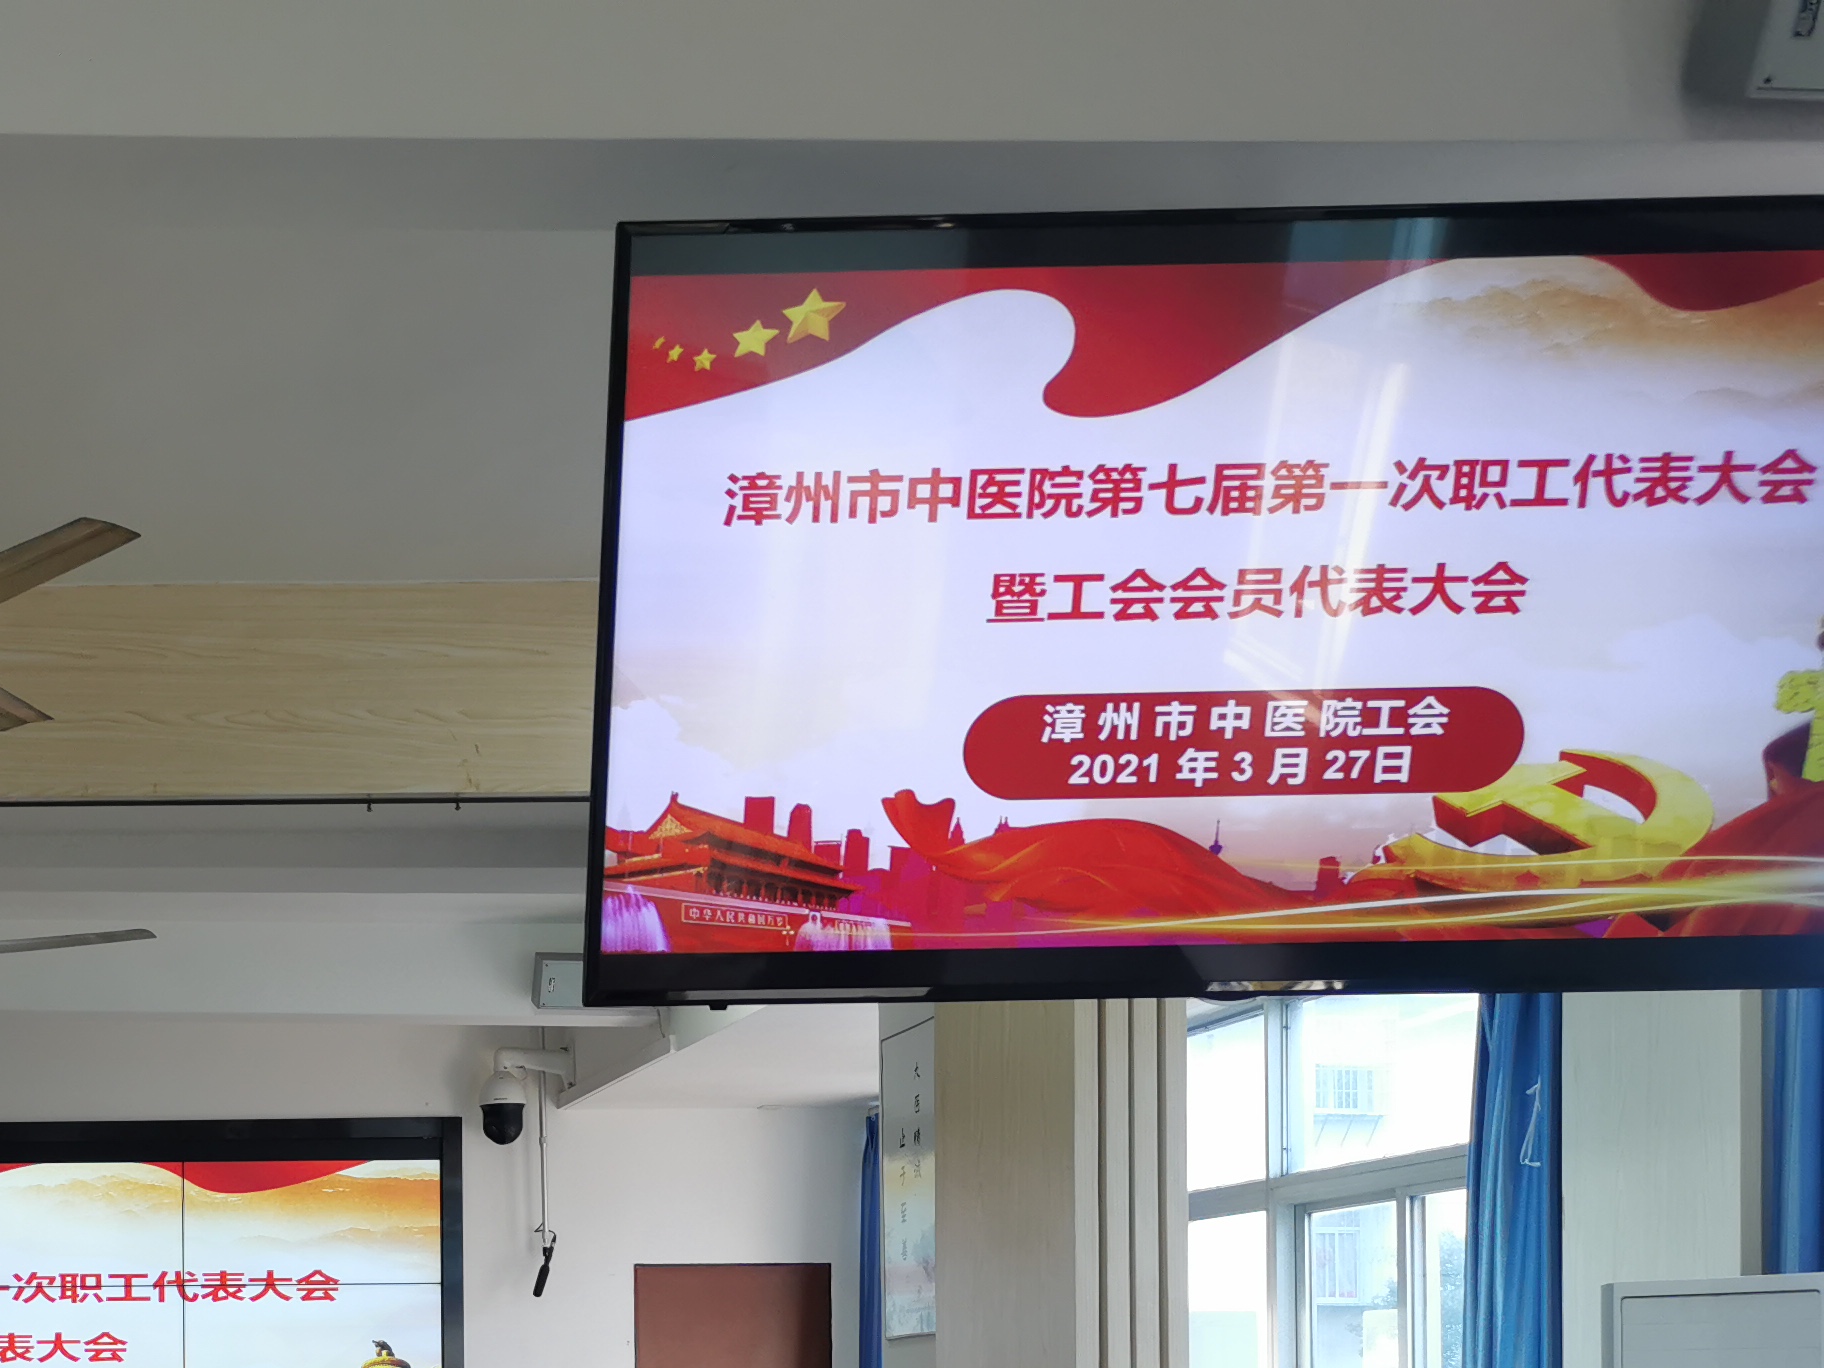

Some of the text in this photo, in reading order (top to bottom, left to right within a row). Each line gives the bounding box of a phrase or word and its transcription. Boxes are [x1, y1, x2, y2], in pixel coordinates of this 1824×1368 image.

[723, 449, 1817, 527] 漳州市中医院第七届第一次职工代表大会
[987, 561, 1528, 624] 暨工会会员代表大会
[1041, 696, 1450, 744] 漳州市中医院工会
